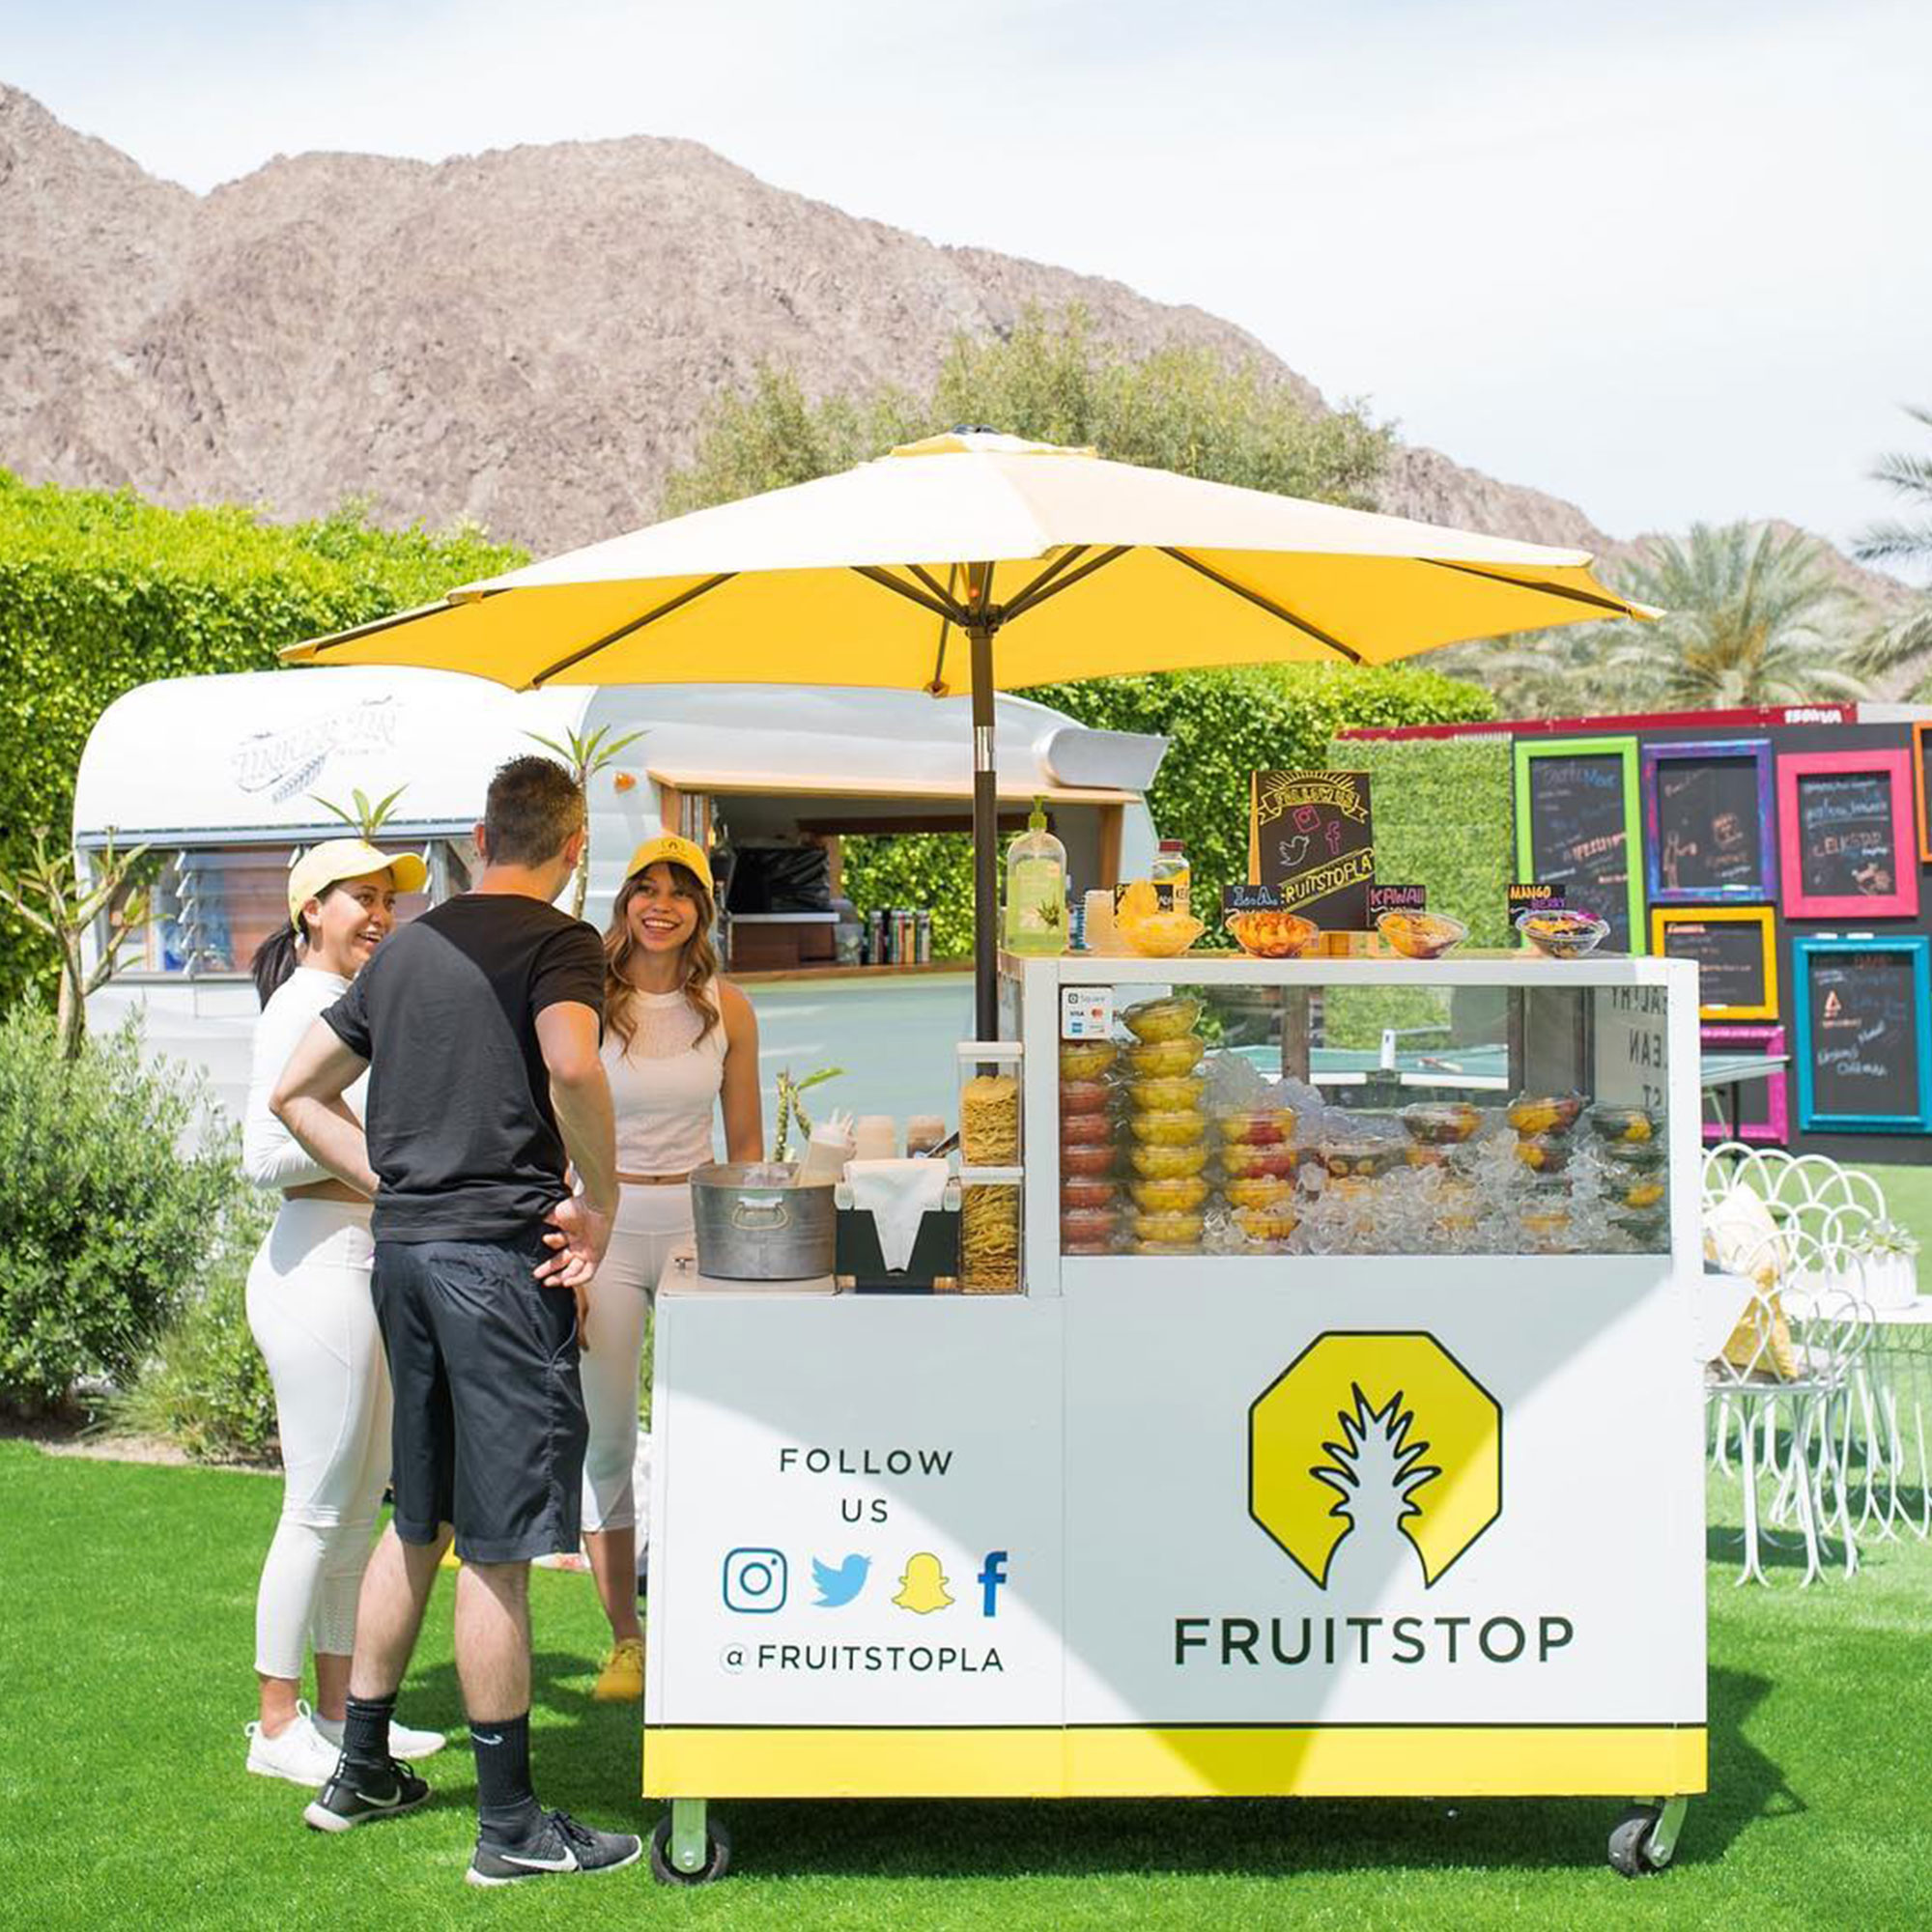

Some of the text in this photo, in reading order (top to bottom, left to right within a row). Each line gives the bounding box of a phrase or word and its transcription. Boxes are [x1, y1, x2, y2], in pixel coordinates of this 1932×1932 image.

[1509, 885, 1551, 899] MANGO
[781, 1449, 953, 1475] FOLLOW
[840, 1498, 889, 1523] US
[1175, 1616, 1574, 1664] FRUITSTOP
